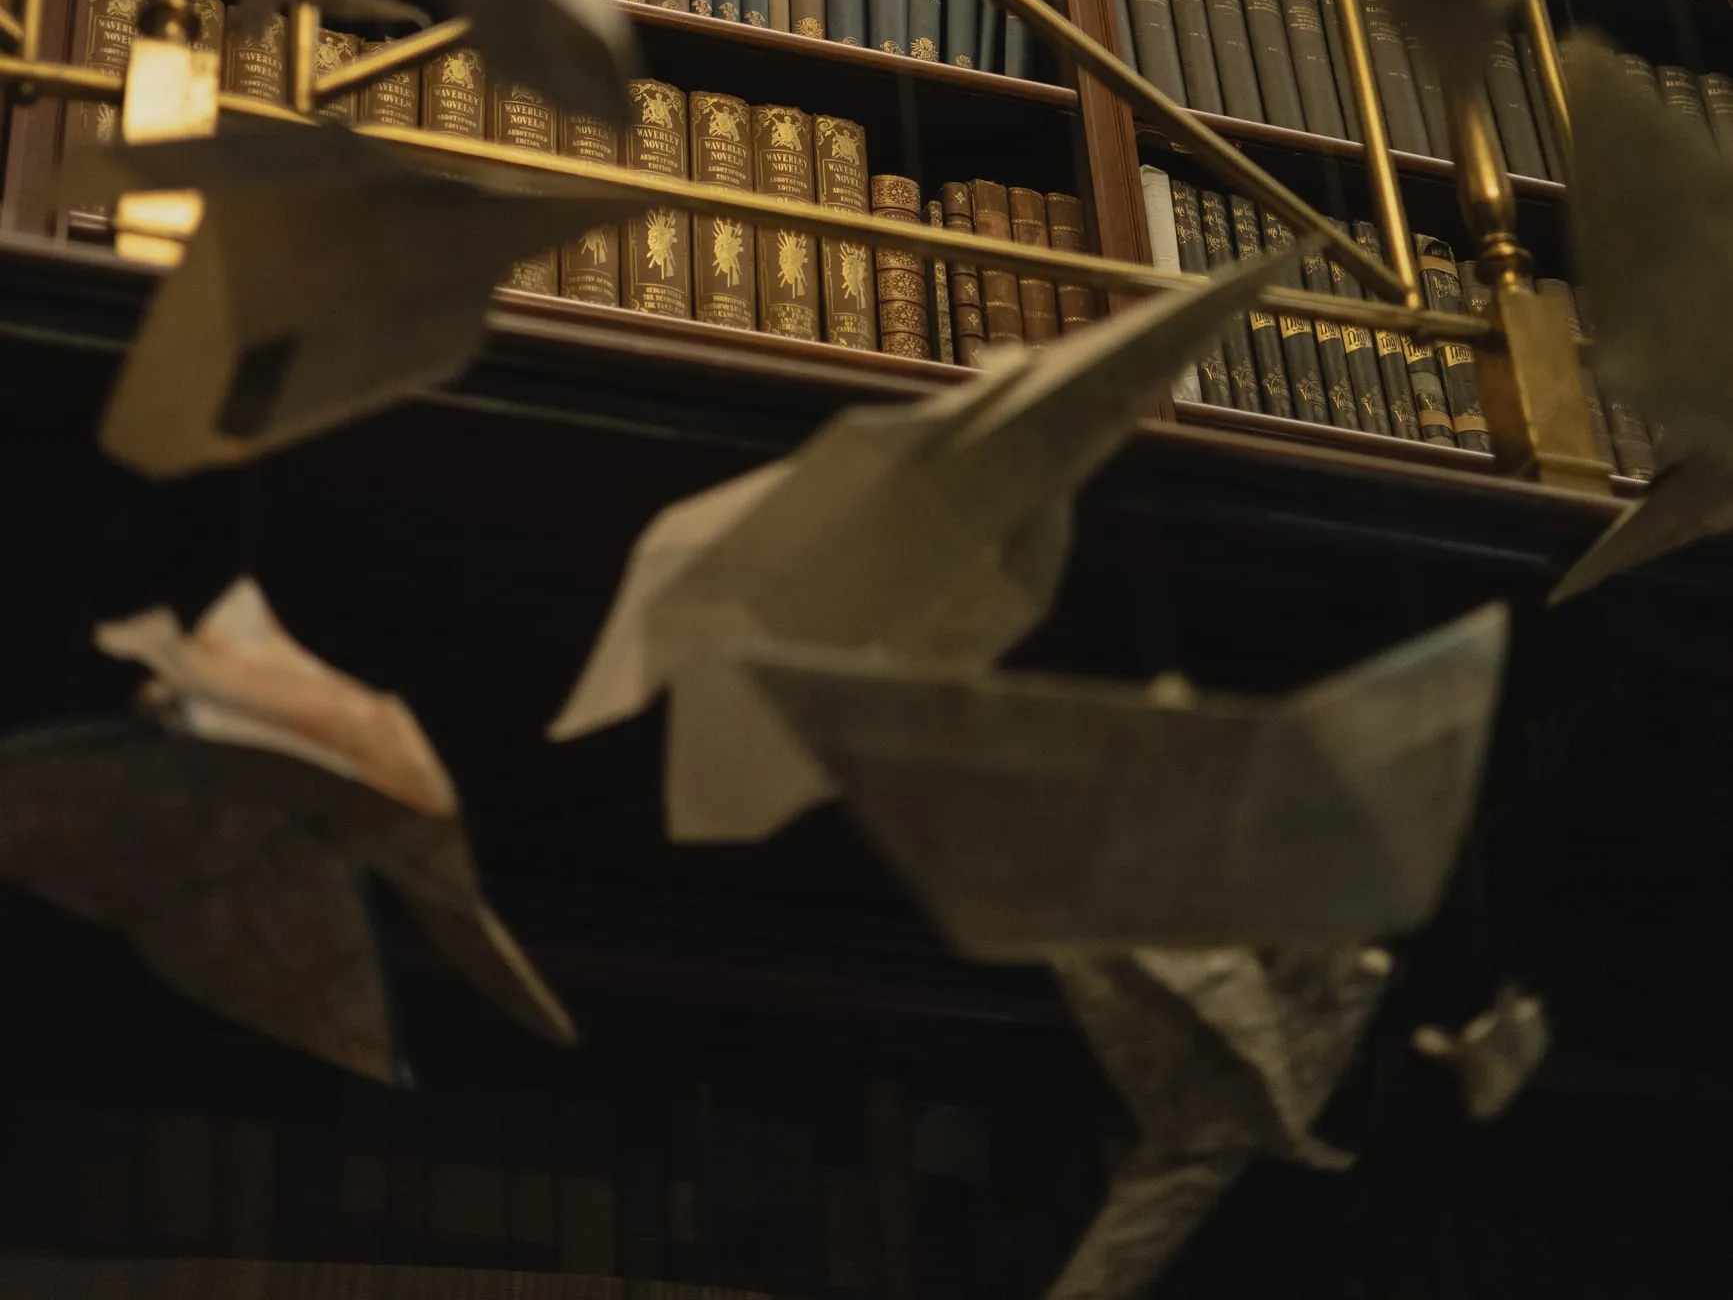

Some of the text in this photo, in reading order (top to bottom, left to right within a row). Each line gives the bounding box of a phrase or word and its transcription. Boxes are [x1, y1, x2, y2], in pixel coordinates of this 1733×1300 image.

[98, 18, 138, 36] WAVERL
[434, 88, 480, 106] WAVERLEY
[440, 99, 474, 115] NOVELS
[504, 103, 550, 121] WAVERLEY
[510, 113, 546, 130] NOVELS
[637, 128, 681, 146] WAVERLEY
[643, 139, 677, 156] NOVELS
[704, 139, 748, 159] WAVERLEY
[711, 151, 745, 167] NOVELS
[766, 151, 808, 170] WAVERLEY
[771, 162, 806, 177] NOVELS
[828, 162, 862, 180] WAVERLE
[835, 173, 863, 189] NOVEL
